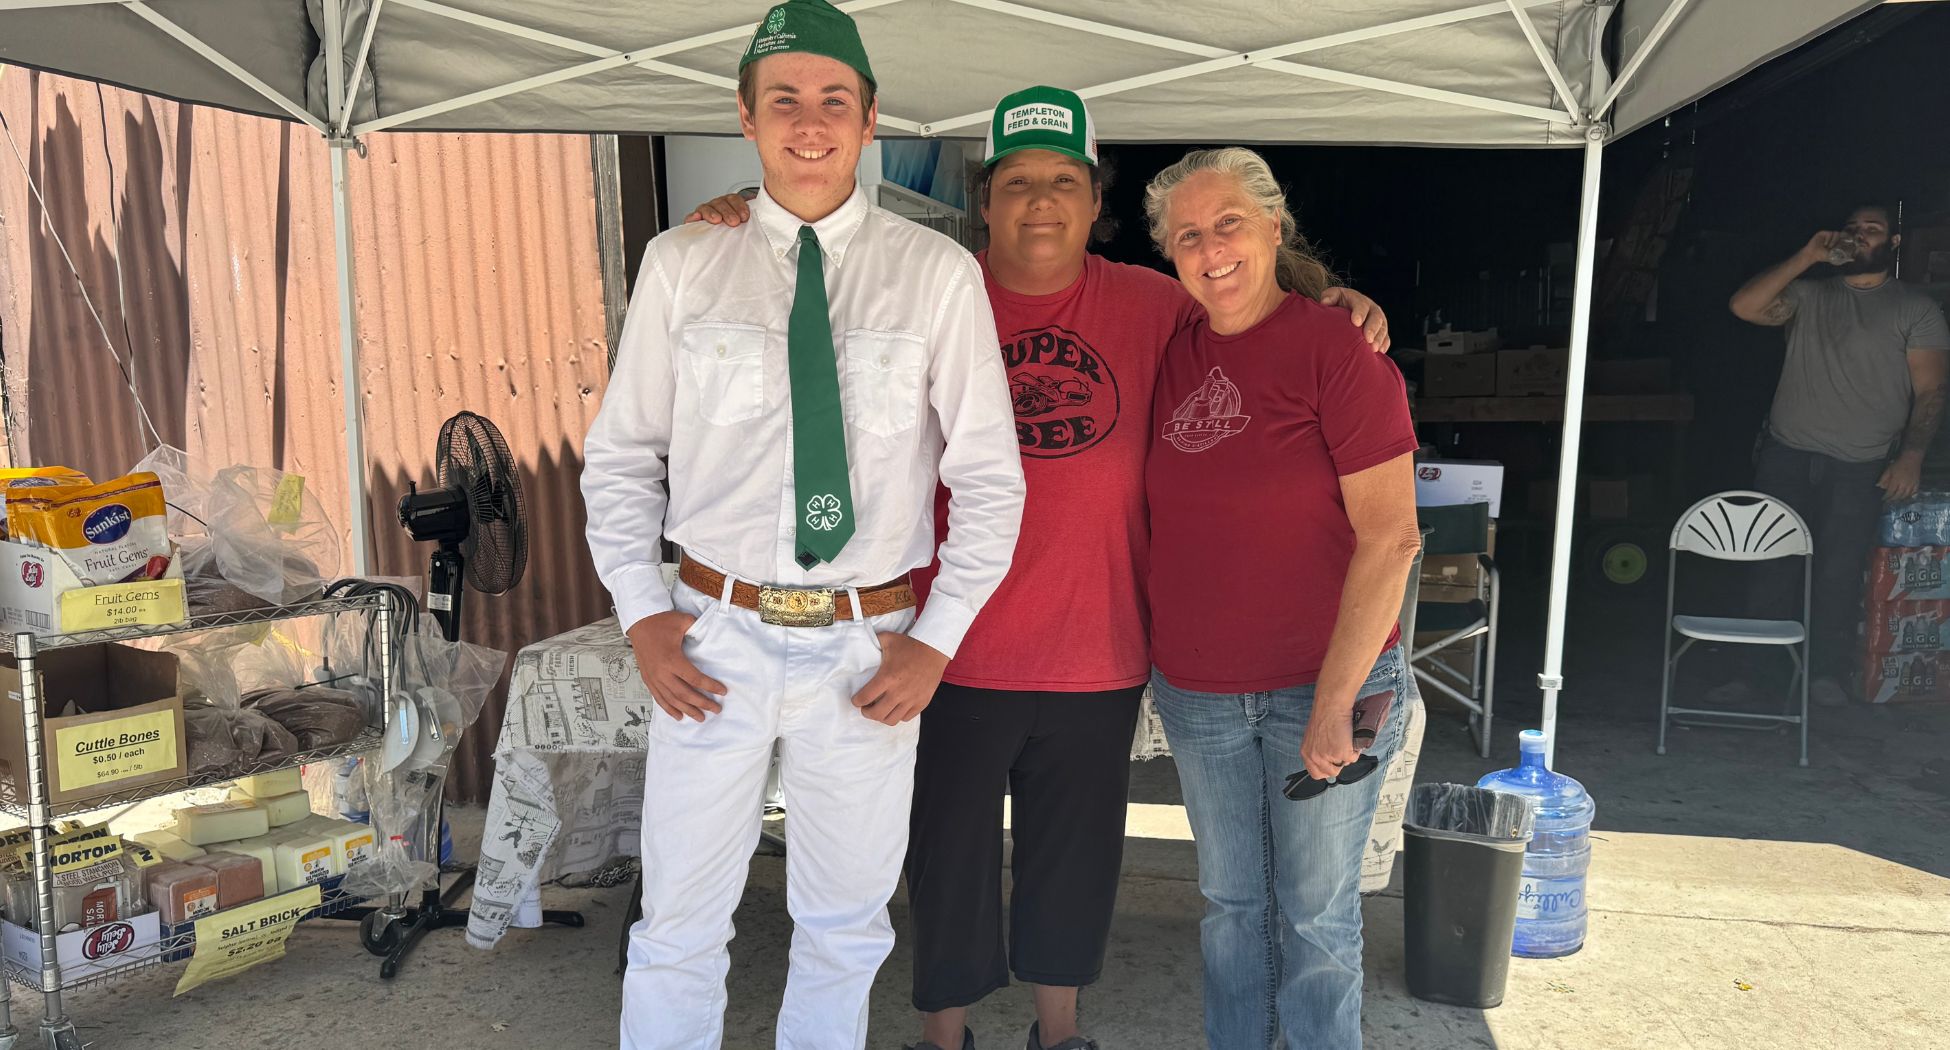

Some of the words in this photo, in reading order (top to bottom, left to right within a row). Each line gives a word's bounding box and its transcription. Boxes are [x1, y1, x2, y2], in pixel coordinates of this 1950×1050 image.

[1011, 107, 1065, 120] TEMPLETON
[1007, 118, 1030, 131] FEED
[1031, 117, 1039, 125] &
[1040, 119, 1068, 129] GRAIN
[1001, 332, 1104, 385] UPER
[1174, 422, 1191, 432] BE
[1196, 419, 1231, 429] STILL
[85, 510, 130, 540] Sunkist
[85, 554, 116, 572] Fruit
[118, 550, 148, 564] Gems
[95, 593, 123, 605] Fruit
[126, 590, 160, 601] Gems
[106, 605, 137, 617] $14.00
[75, 737, 116, 754] Cuttle
[118, 729, 160, 745] Bones
[92, 752, 117, 765] $0.50
[119, 751, 122, 760] /
[124, 747, 145, 758] each
[61, 872, 81, 882] STEEL
[81, 860, 120, 877] STANCHION
[1518, 883, 1581, 912] Cullig
[86, 908, 96, 927] SAL
[95, 901, 105, 924] MORT
[222, 920, 256, 939] SALT
[260, 907, 300, 928] BRICK
[102, 925, 127, 942] Belly
[96, 939, 119, 957] Jelly
[227, 941, 264, 957] $2.20
[266, 936, 282, 945] ea
